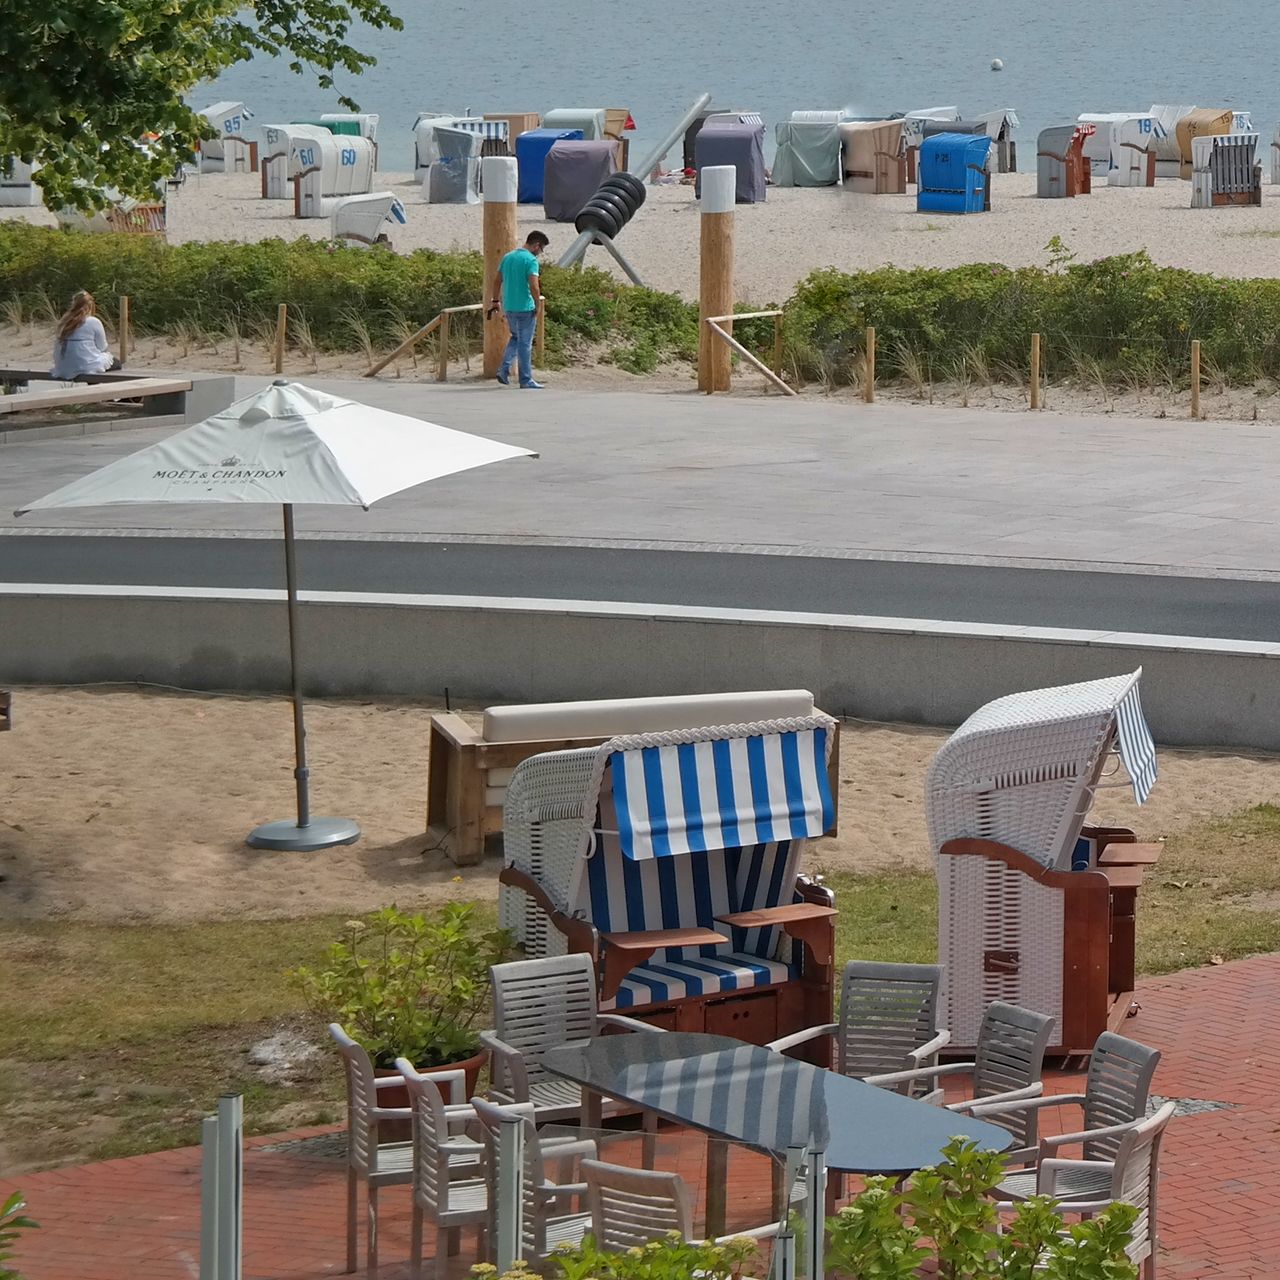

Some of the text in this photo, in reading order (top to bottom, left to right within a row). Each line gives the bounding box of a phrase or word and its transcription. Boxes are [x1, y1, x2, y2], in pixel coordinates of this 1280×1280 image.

[224, 116, 241, 134] 85
[1138, 119, 1151, 133] 18
[300, 147, 314, 166] 60
[341, 148, 356, 166] 60
[212, 470, 288, 479] CHANDON
